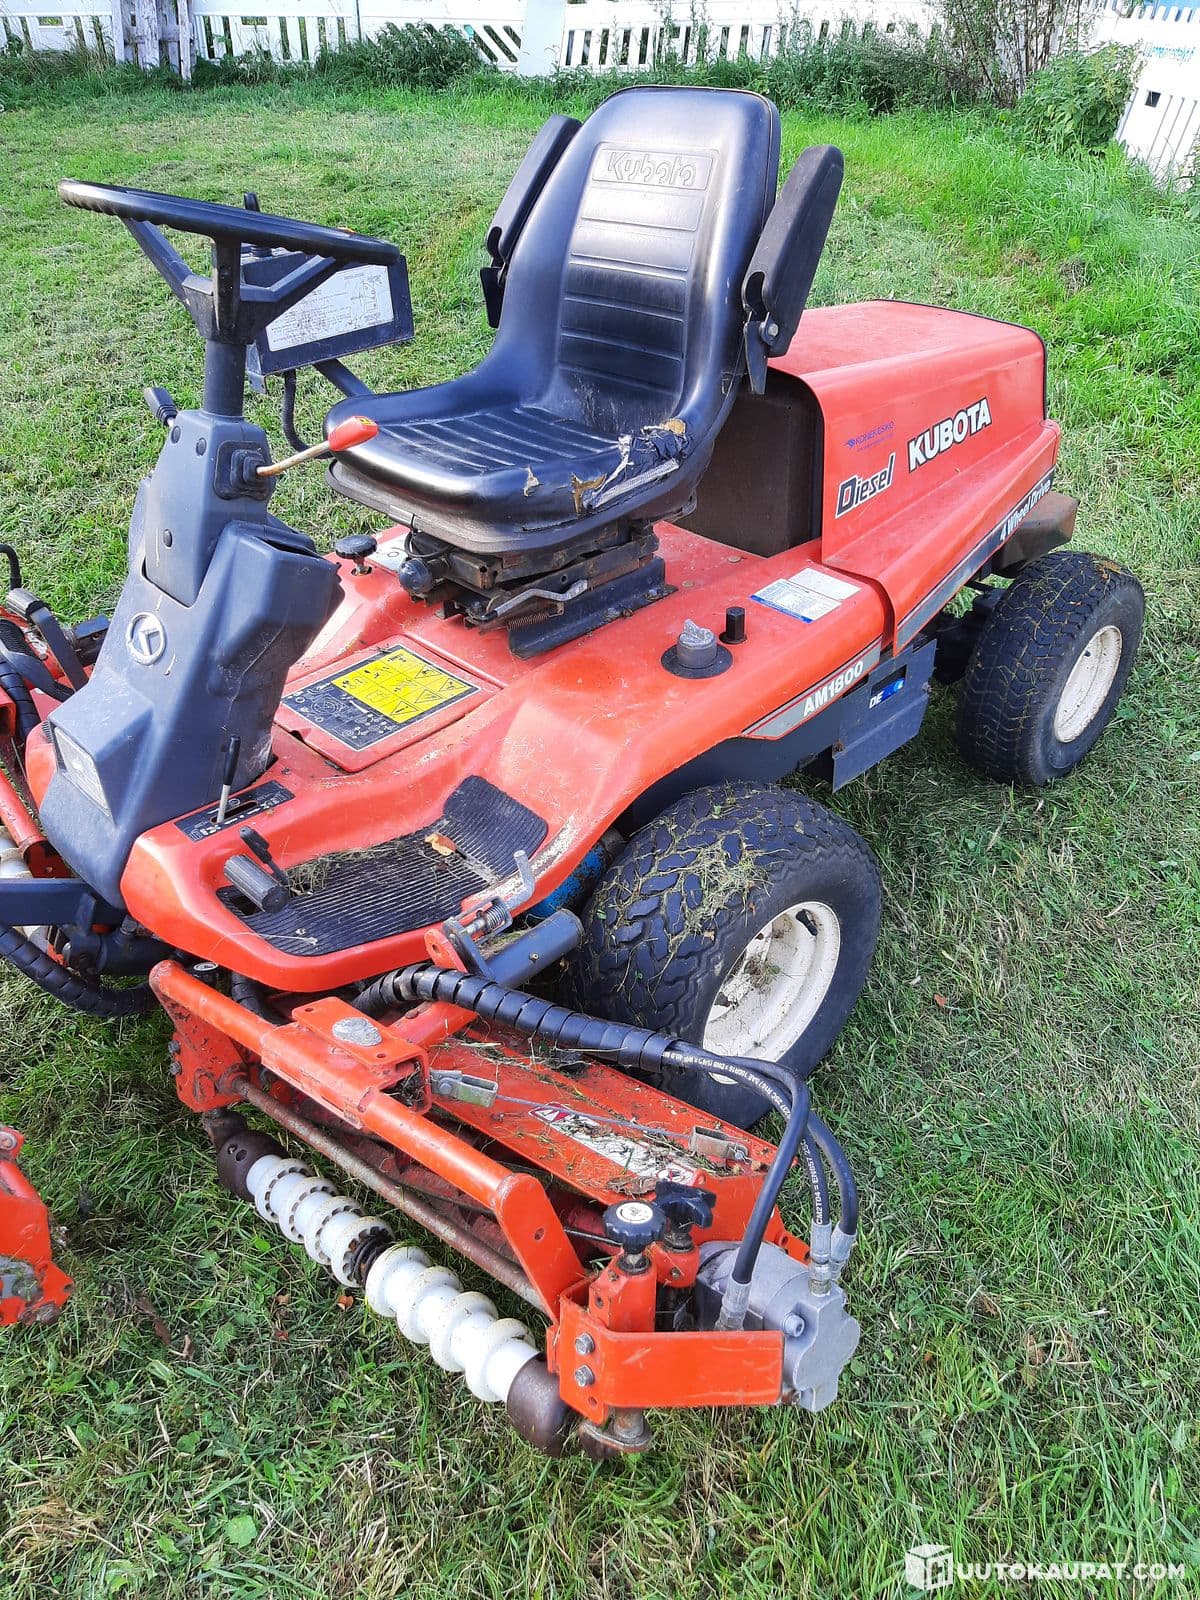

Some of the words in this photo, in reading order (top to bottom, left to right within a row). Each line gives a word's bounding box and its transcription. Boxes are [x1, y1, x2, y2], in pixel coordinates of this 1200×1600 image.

[907, 397, 992, 473] KUBOTA
[835, 451, 896, 519] Diesel
[1000, 523, 1007, 541] 4
[1007, 495, 1031, 535] Wheel
[1030, 479, 1051, 510] Drive
[803, 660, 864, 717] AM1800
